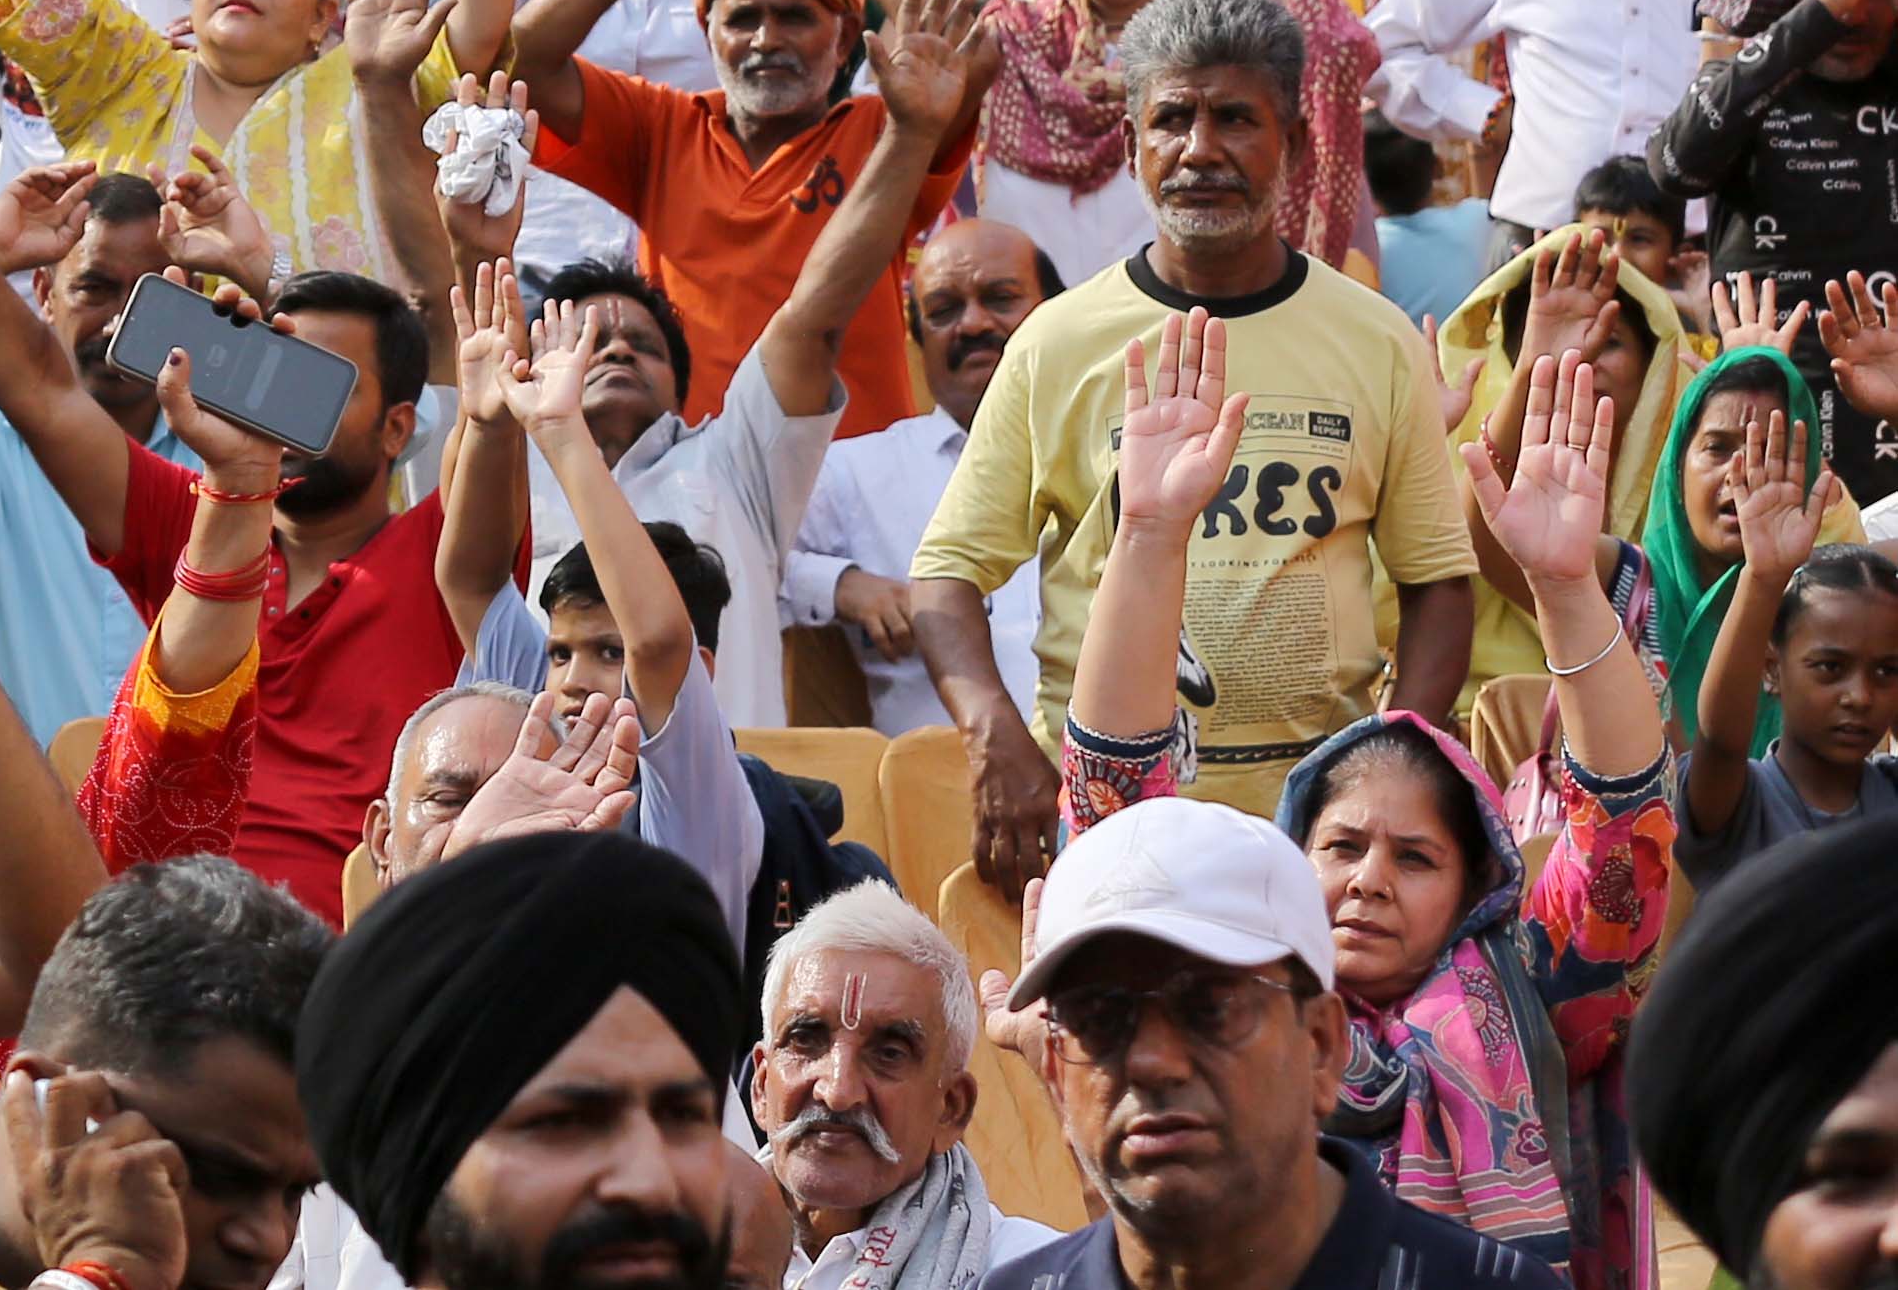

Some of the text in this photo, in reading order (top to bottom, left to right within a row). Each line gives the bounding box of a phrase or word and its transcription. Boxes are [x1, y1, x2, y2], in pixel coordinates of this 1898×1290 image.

[1246, 412, 1305, 431] CEAN
[1316, 415, 1342, 427] DAILY
[1312, 425, 1347, 438] REPORT
[1200, 558, 1259, 568] LOOKING
